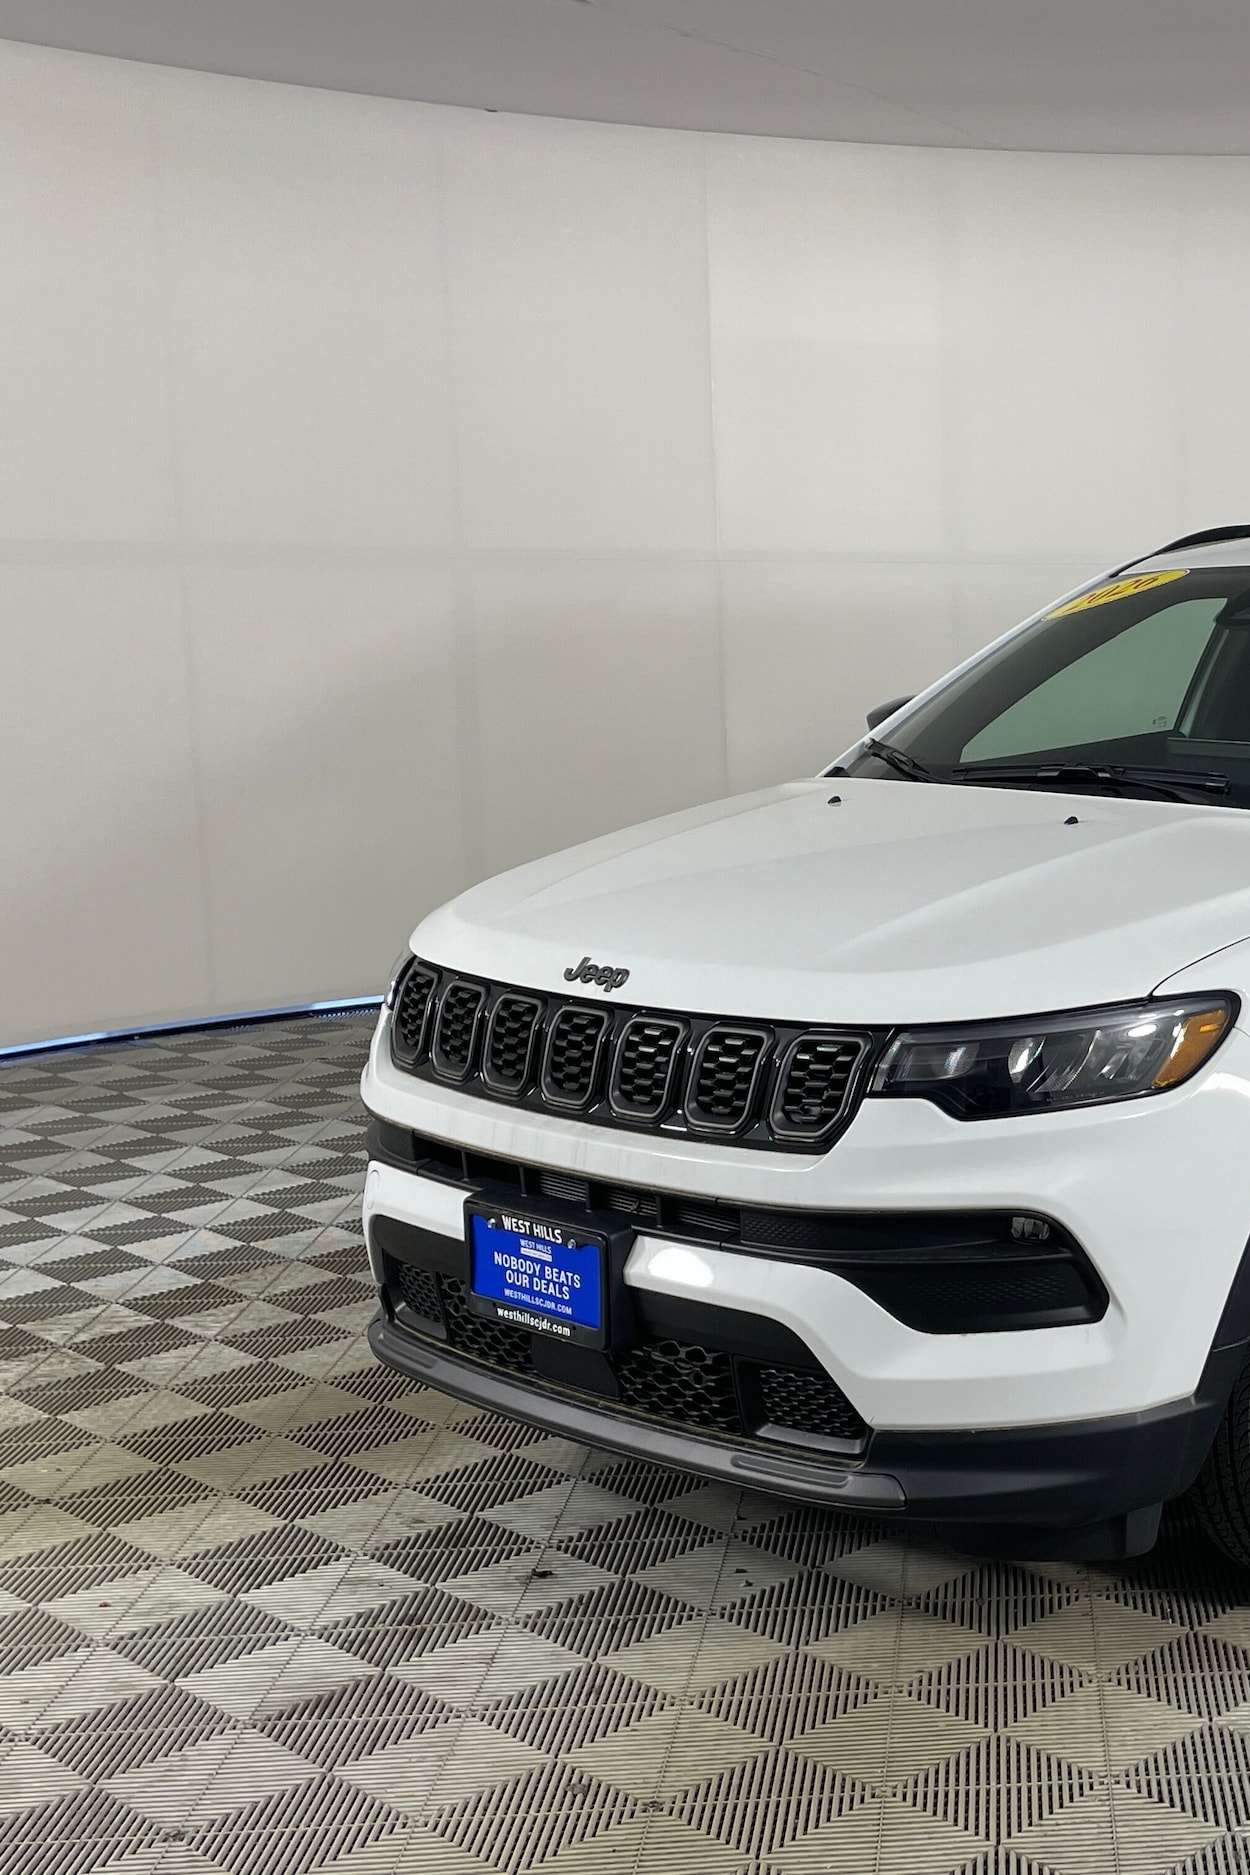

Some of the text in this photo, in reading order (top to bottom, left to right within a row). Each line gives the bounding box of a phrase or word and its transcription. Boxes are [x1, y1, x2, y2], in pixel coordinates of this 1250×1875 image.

[563, 956, 630, 993] Jeep
[501, 1214, 563, 1244] WEST HILLS
[519, 1238, 536, 1249] WEST
[536, 1242, 552, 1255] HILLS
[494, 1251, 541, 1277] NOBODY
[544, 1265, 582, 1288] BEATS
[505, 1270, 570, 1300] OUR DEALS
[504, 1287, 573, 1315] WESTHILLSCJDR.COM
[497, 1307, 571, 1337] westhillscjdr.com
